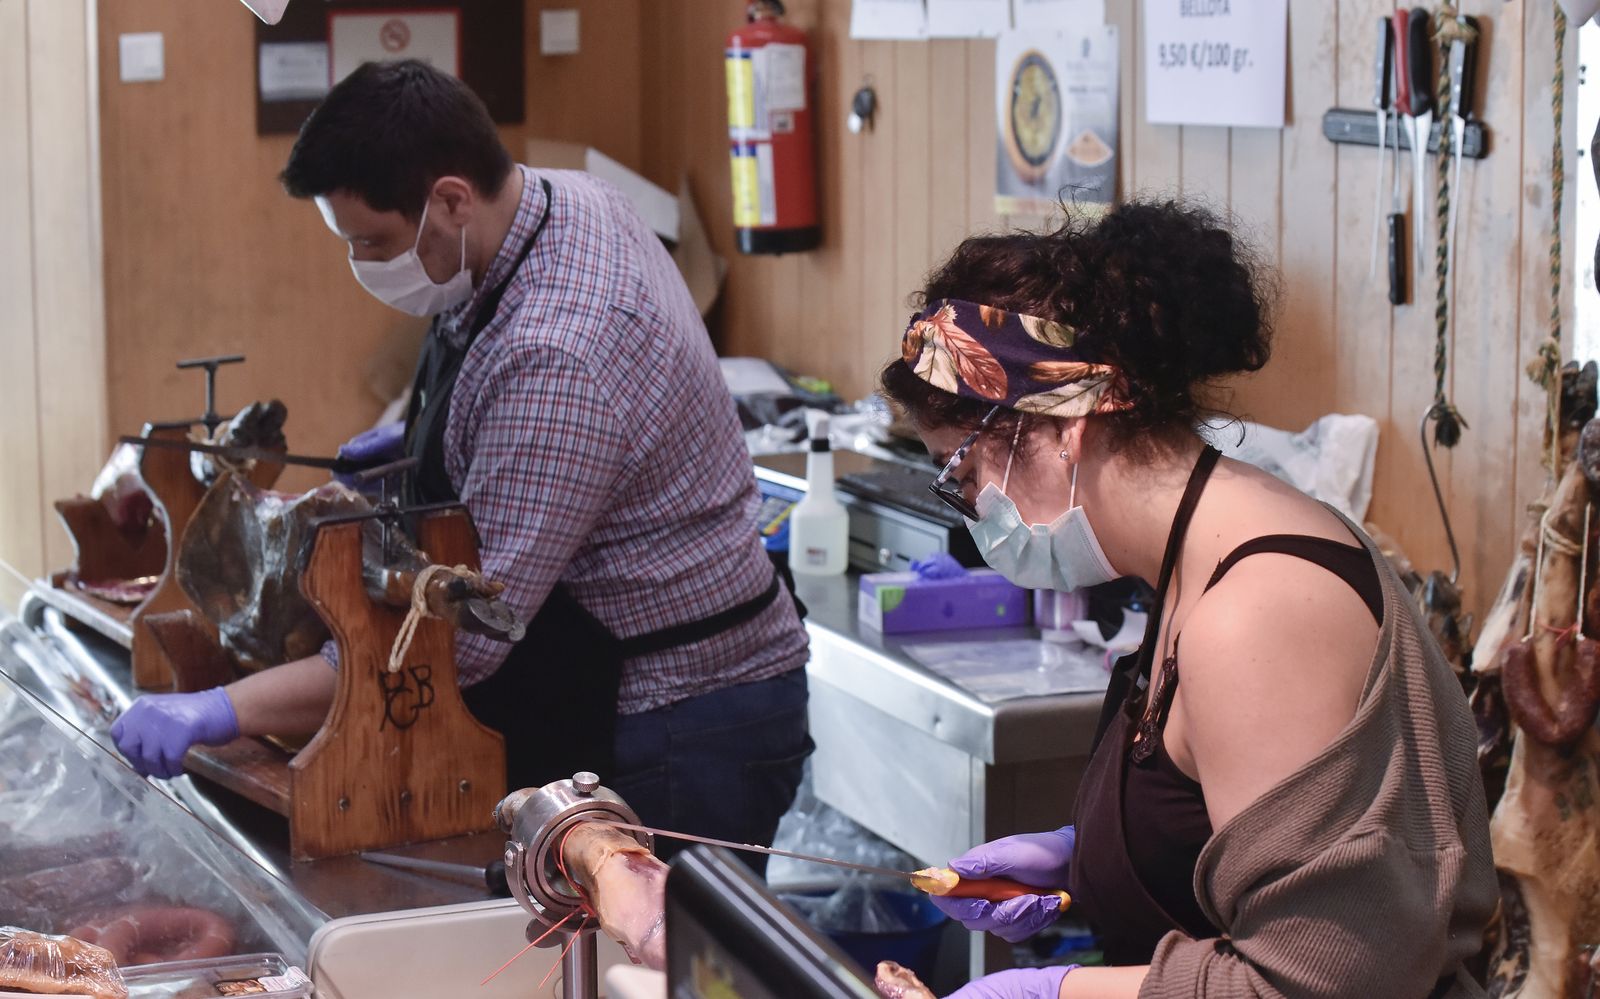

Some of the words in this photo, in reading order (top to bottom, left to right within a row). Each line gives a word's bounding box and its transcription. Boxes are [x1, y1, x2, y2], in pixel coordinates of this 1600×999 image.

[1180, 0, 1230, 17] BELLOTA
[1159, 43, 1187, 70] 9,50
[1190, 41, 1231, 71] €/100
[1233, 48, 1254, 73] gr.
